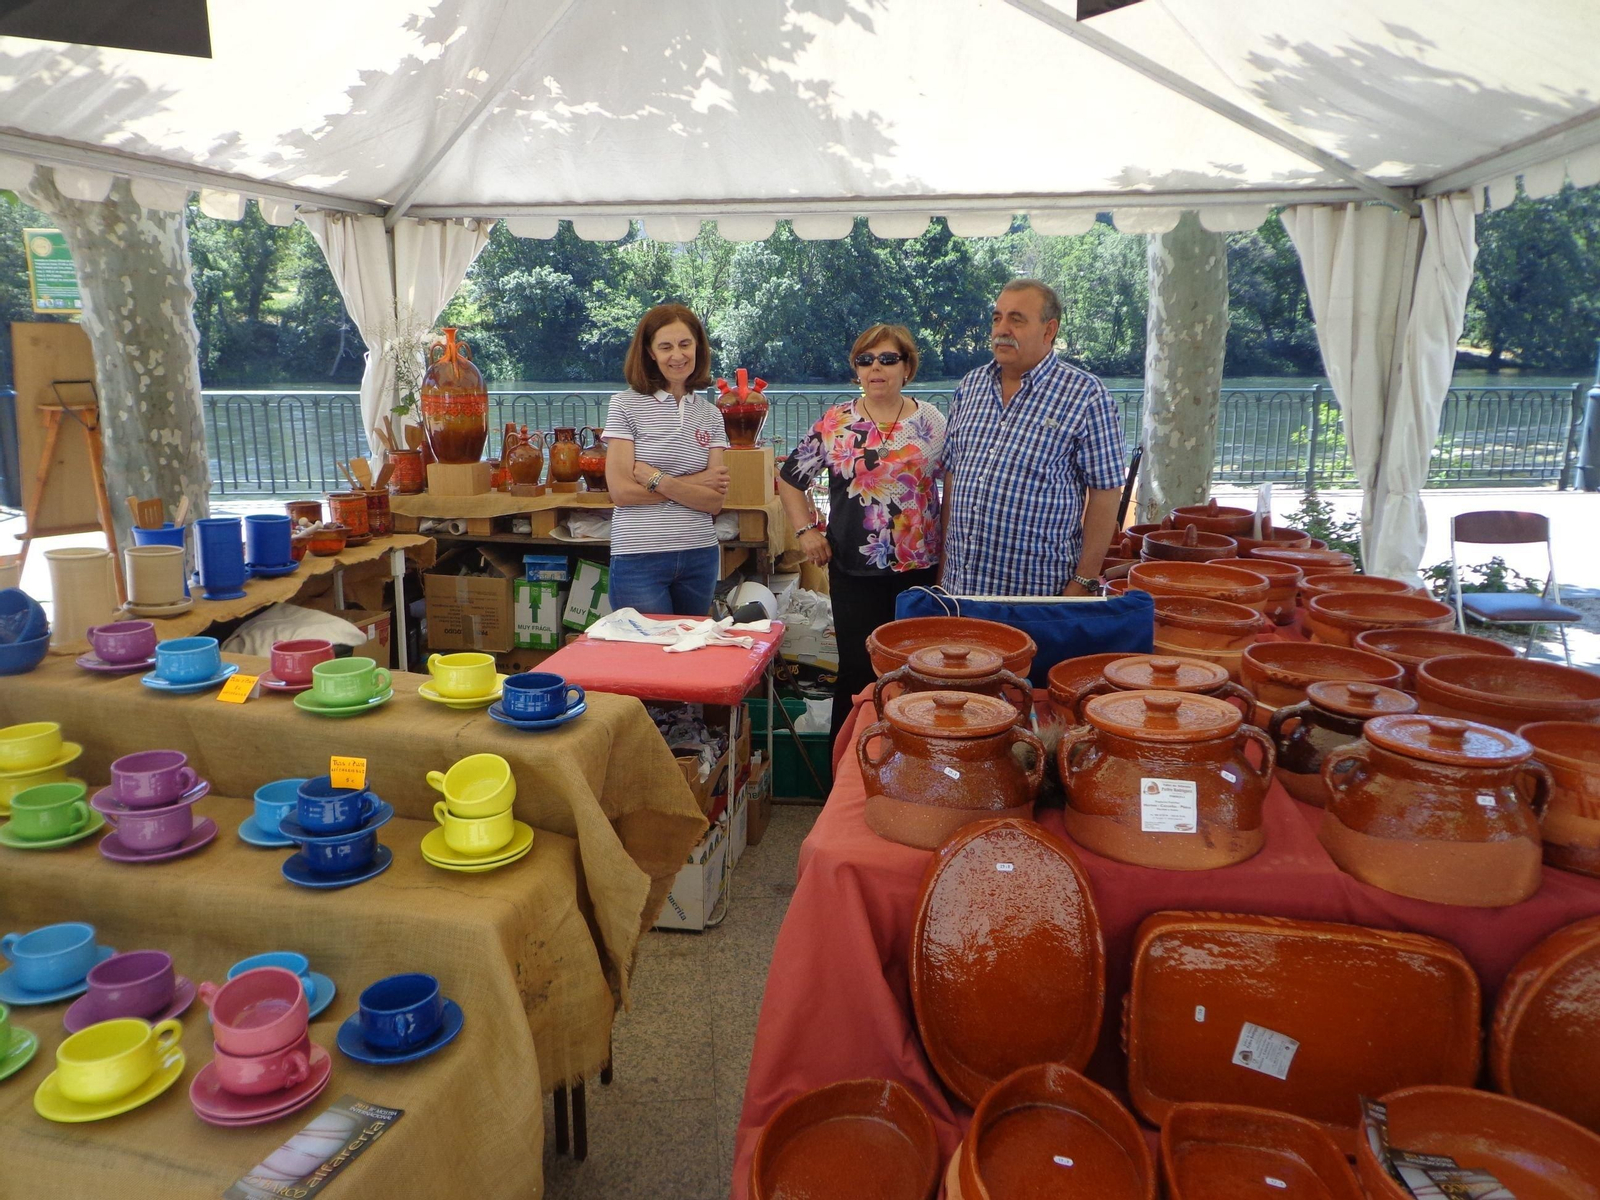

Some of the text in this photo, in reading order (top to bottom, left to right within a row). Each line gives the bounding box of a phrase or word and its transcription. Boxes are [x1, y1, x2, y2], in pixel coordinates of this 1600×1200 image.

[569, 606, 587, 616] MUY
[517, 623, 531, 631] MUY
[667, 892, 687, 921] merita
[263, 1180, 307, 1198] BARCO
